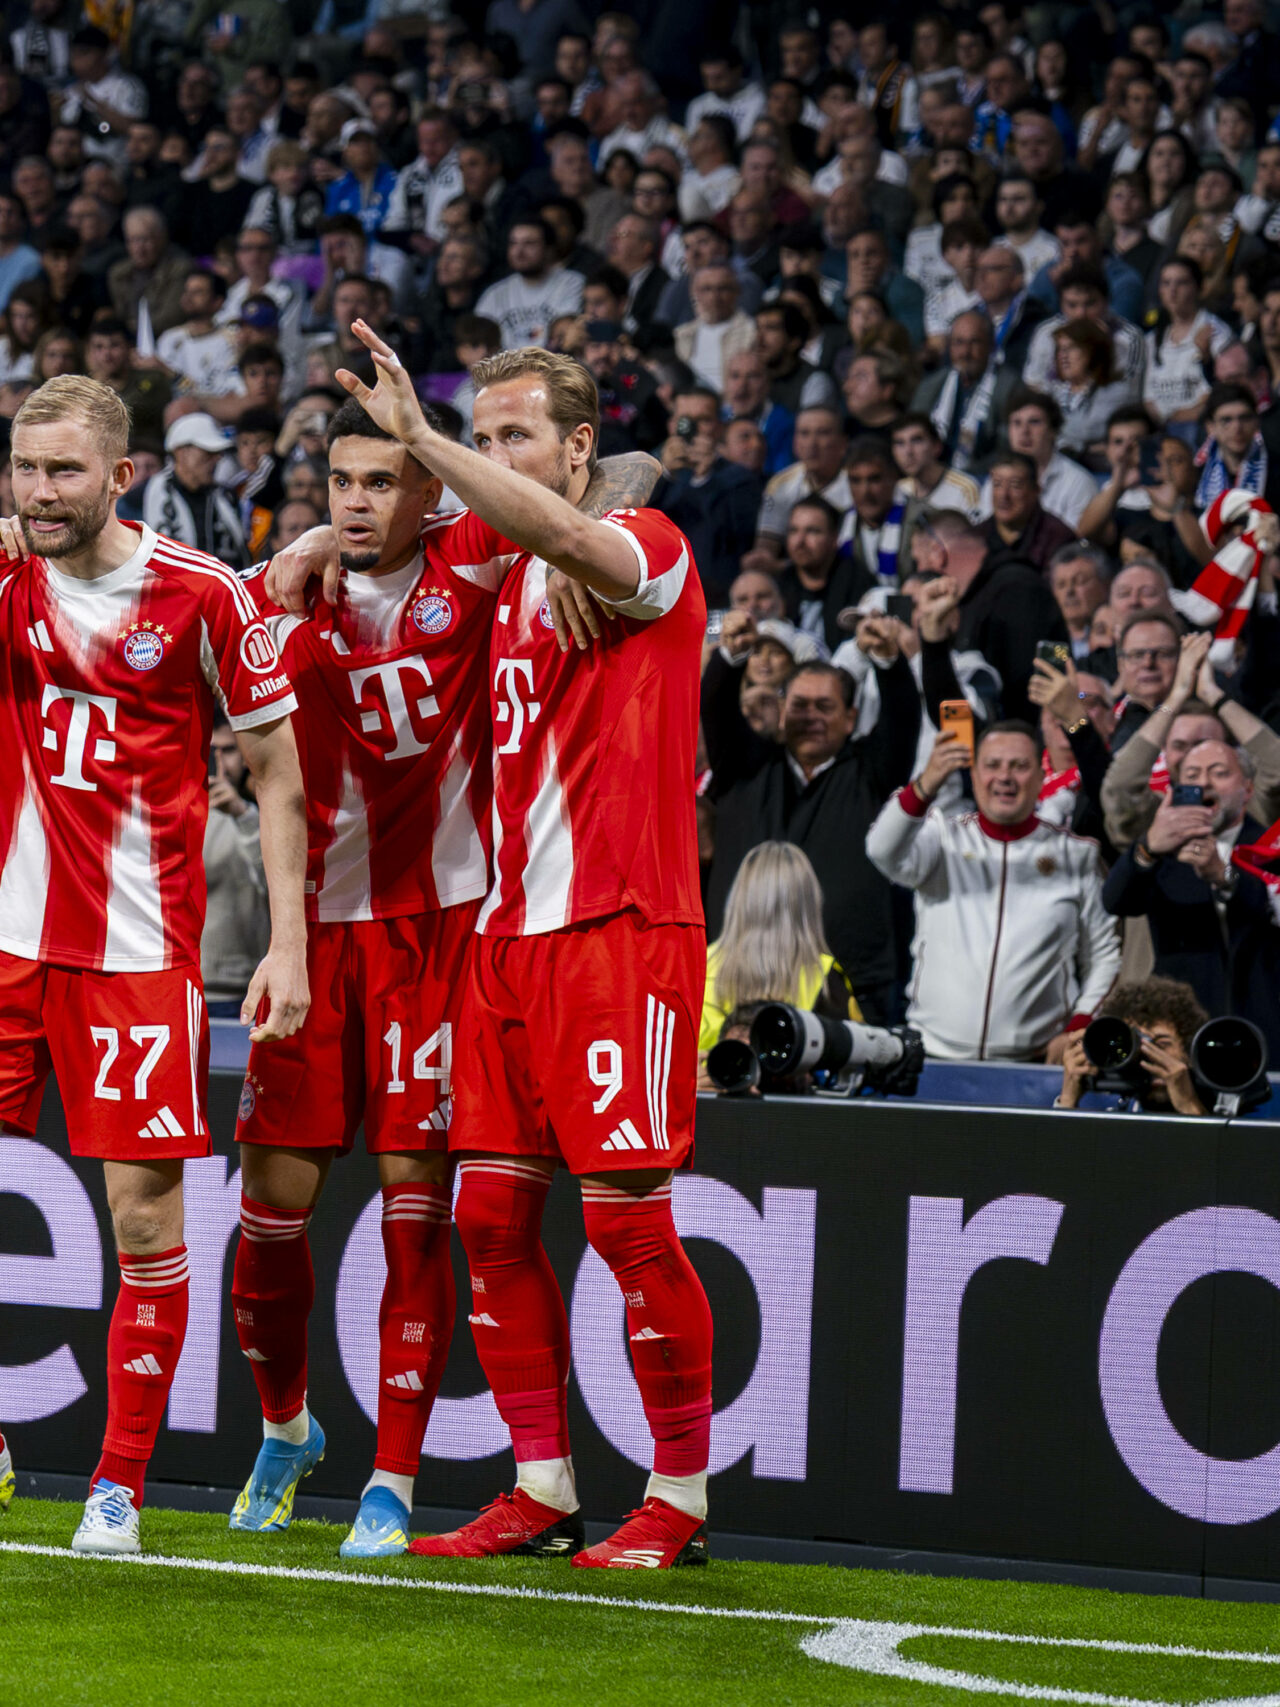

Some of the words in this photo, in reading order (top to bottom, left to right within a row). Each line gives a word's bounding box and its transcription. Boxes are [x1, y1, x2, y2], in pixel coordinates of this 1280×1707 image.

[249, 672, 291, 702] Allian
[41, 683, 117, 792] T
[383, 1021, 452, 1095] 14
[90, 1025, 170, 1101] 27
[587, 1039, 622, 1114] 9
[137, 1303, 156, 1312] MIA
[137, 1311, 155, 1320] SAN
[135, 1318, 155, 1327] MIA
[404, 1321, 426, 1329] MIA
[402, 1328, 425, 1336] SAN
[402, 1334, 423, 1343] MIA
